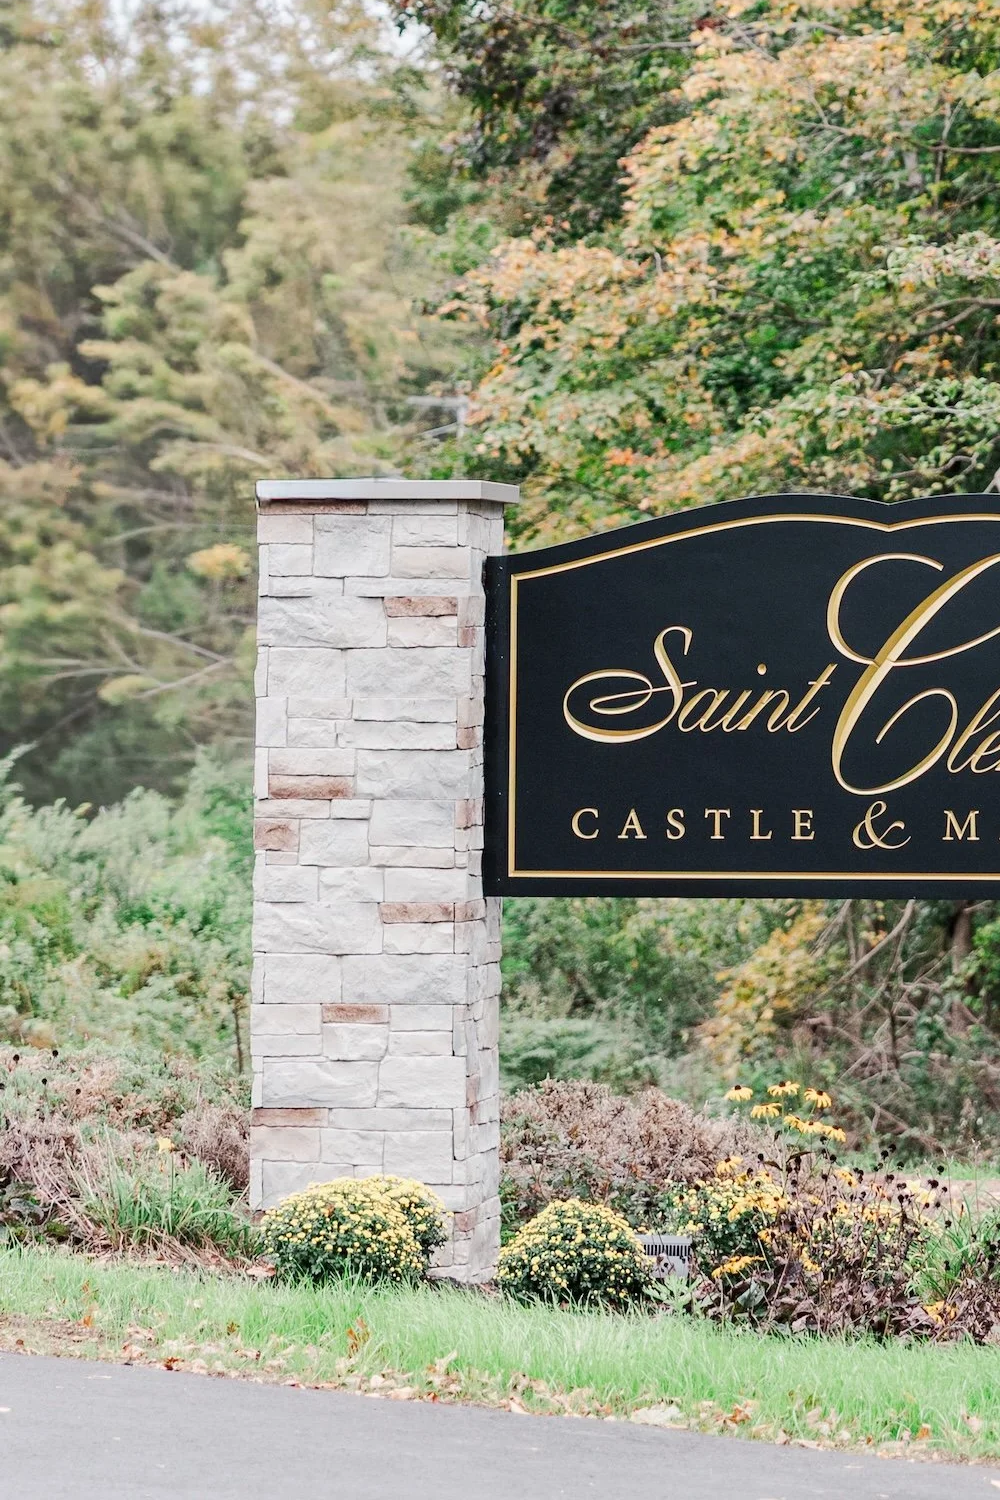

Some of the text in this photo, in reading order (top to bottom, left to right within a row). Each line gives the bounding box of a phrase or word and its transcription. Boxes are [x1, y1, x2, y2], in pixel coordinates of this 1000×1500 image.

[562, 625, 838, 744] Saint
[571, 807, 815, 841] CASTLE
[852, 800, 912, 850] &
